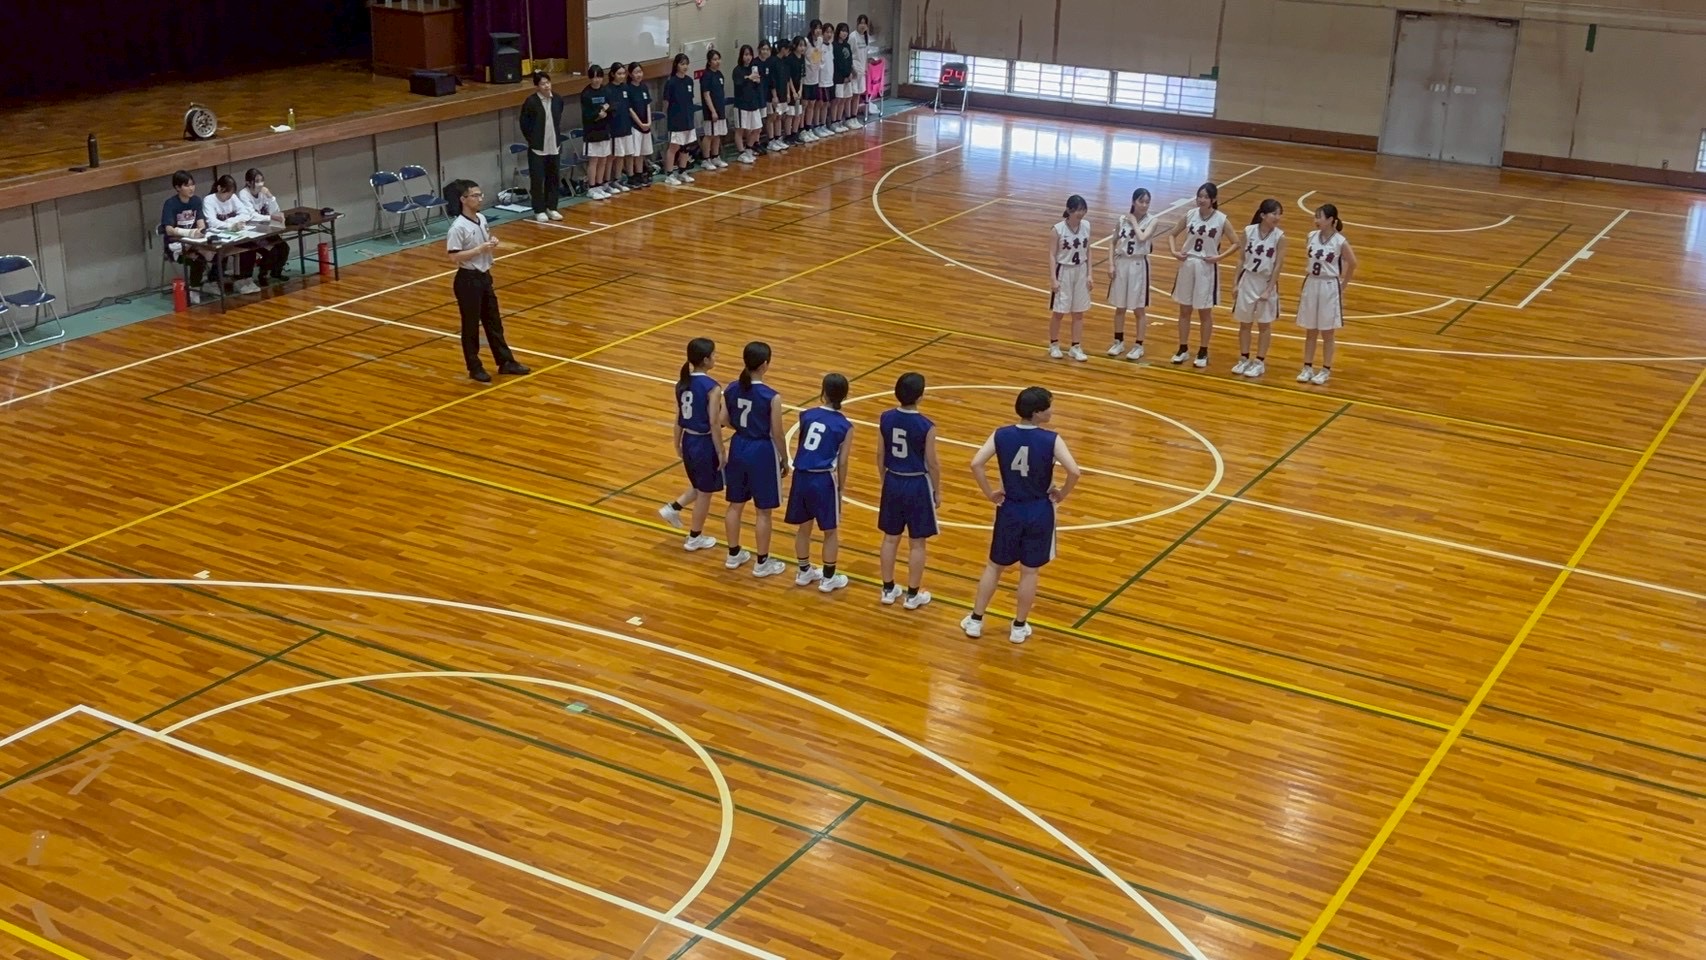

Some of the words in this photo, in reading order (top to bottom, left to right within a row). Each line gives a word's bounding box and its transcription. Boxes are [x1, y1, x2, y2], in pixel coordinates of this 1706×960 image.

[941, 68, 965, 83] 24
[1194, 238, 1203, 252] 6
[1072, 252, 1080, 265] 4
[1252, 258, 1262, 272] 7
[1312, 262, 1321, 276] 9
[681, 391, 693, 419] 8
[737, 398, 752, 427] 7
[803, 421, 826, 451] 6
[891, 428, 909, 459] 5
[1011, 446, 1030, 477] 4
